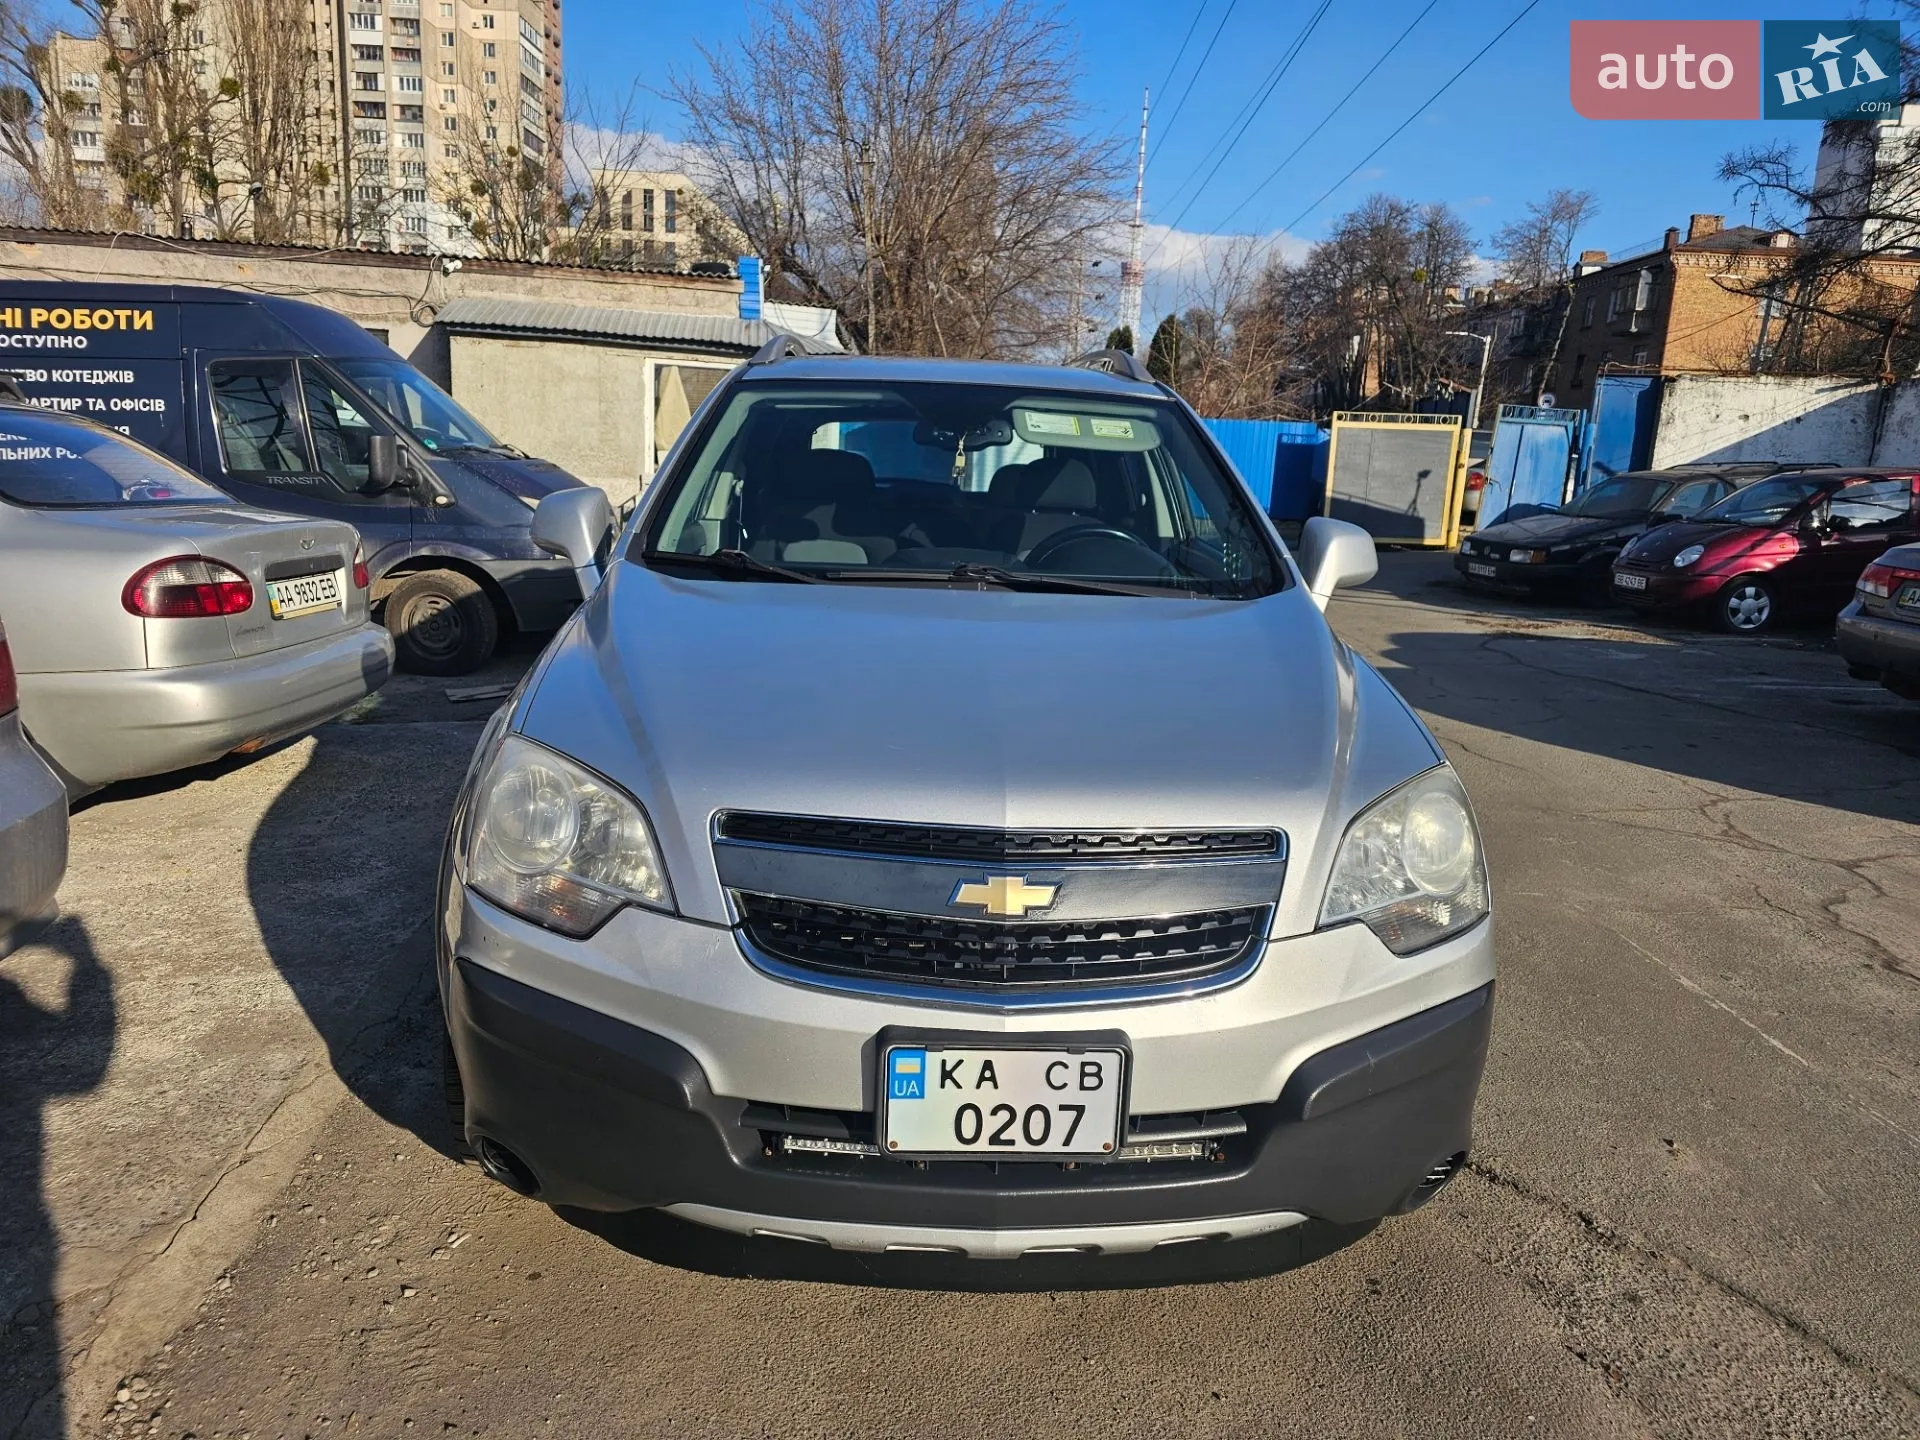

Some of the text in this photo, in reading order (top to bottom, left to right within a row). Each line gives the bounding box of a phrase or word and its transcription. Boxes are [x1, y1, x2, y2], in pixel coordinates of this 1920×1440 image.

[30, 308, 154, 330] РОБОТИ
[52, 369, 135, 384] КОТЕДЖІВ
[86, 398, 106, 411] ТА
[110, 398, 165, 412] ОФІСІВ
[294, 580, 321, 605] 9832
[894, 1058, 1104, 1097] UA KA CB
[954, 1102, 1086, 1147] 0207
